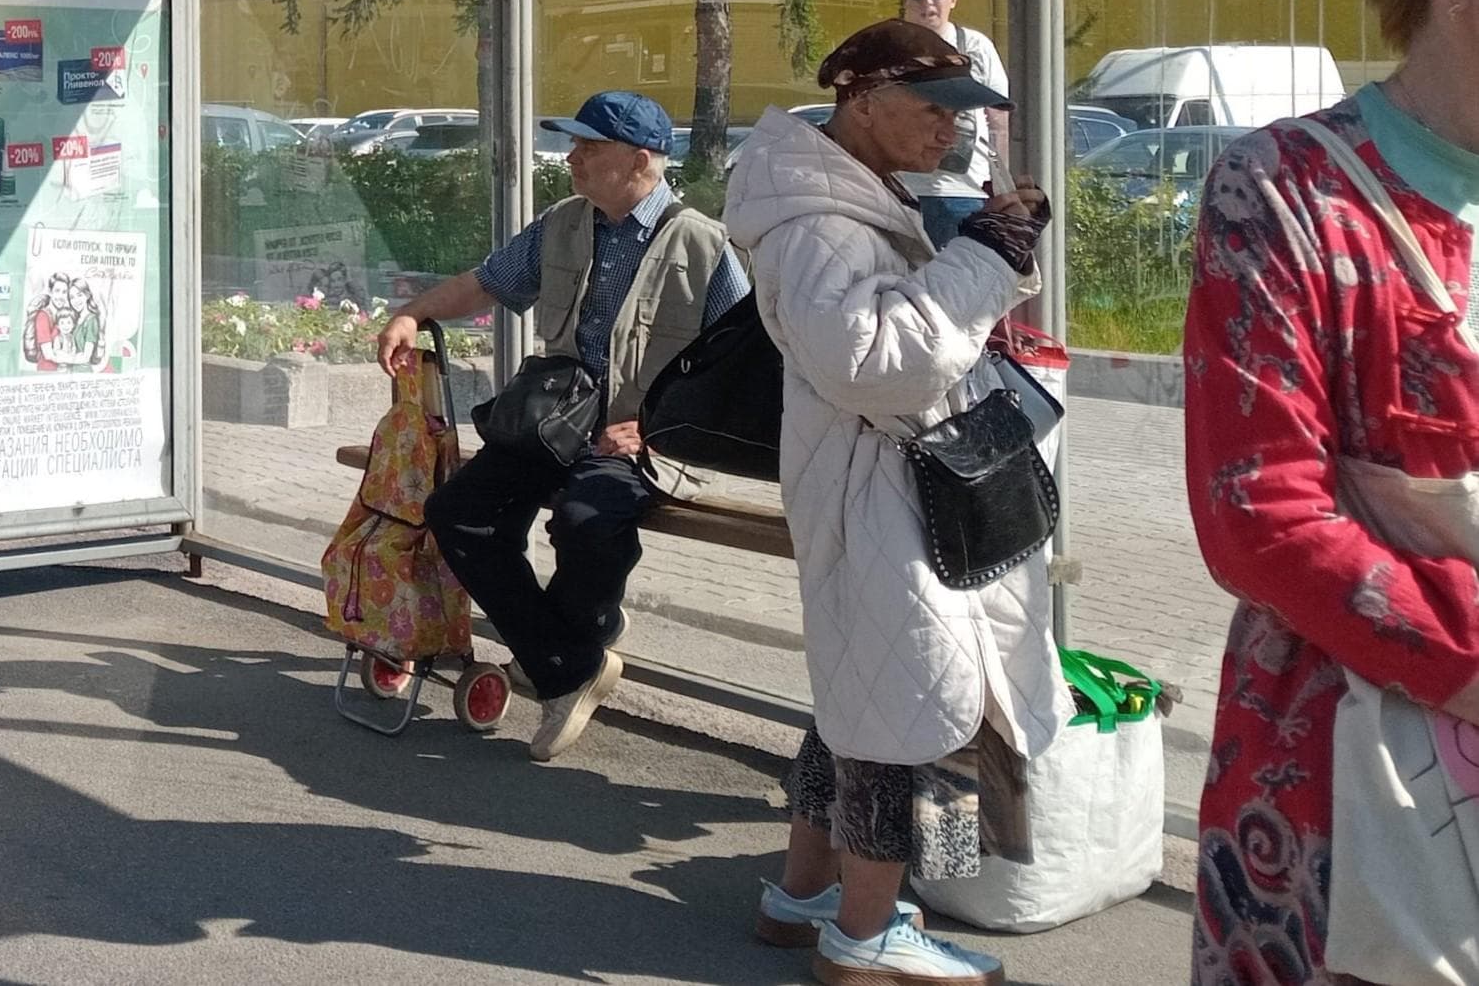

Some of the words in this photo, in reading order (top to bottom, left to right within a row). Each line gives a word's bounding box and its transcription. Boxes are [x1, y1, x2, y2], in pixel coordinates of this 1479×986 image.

[93, 50, 122, 67] -20%
[10, 147, 40, 165] -20%
[55, 139, 84, 157] -20%
[55, 427, 143, 453] НЕОБХОДИМО
[47, 447, 142, 476] СПЕЦИАЛИСТА
